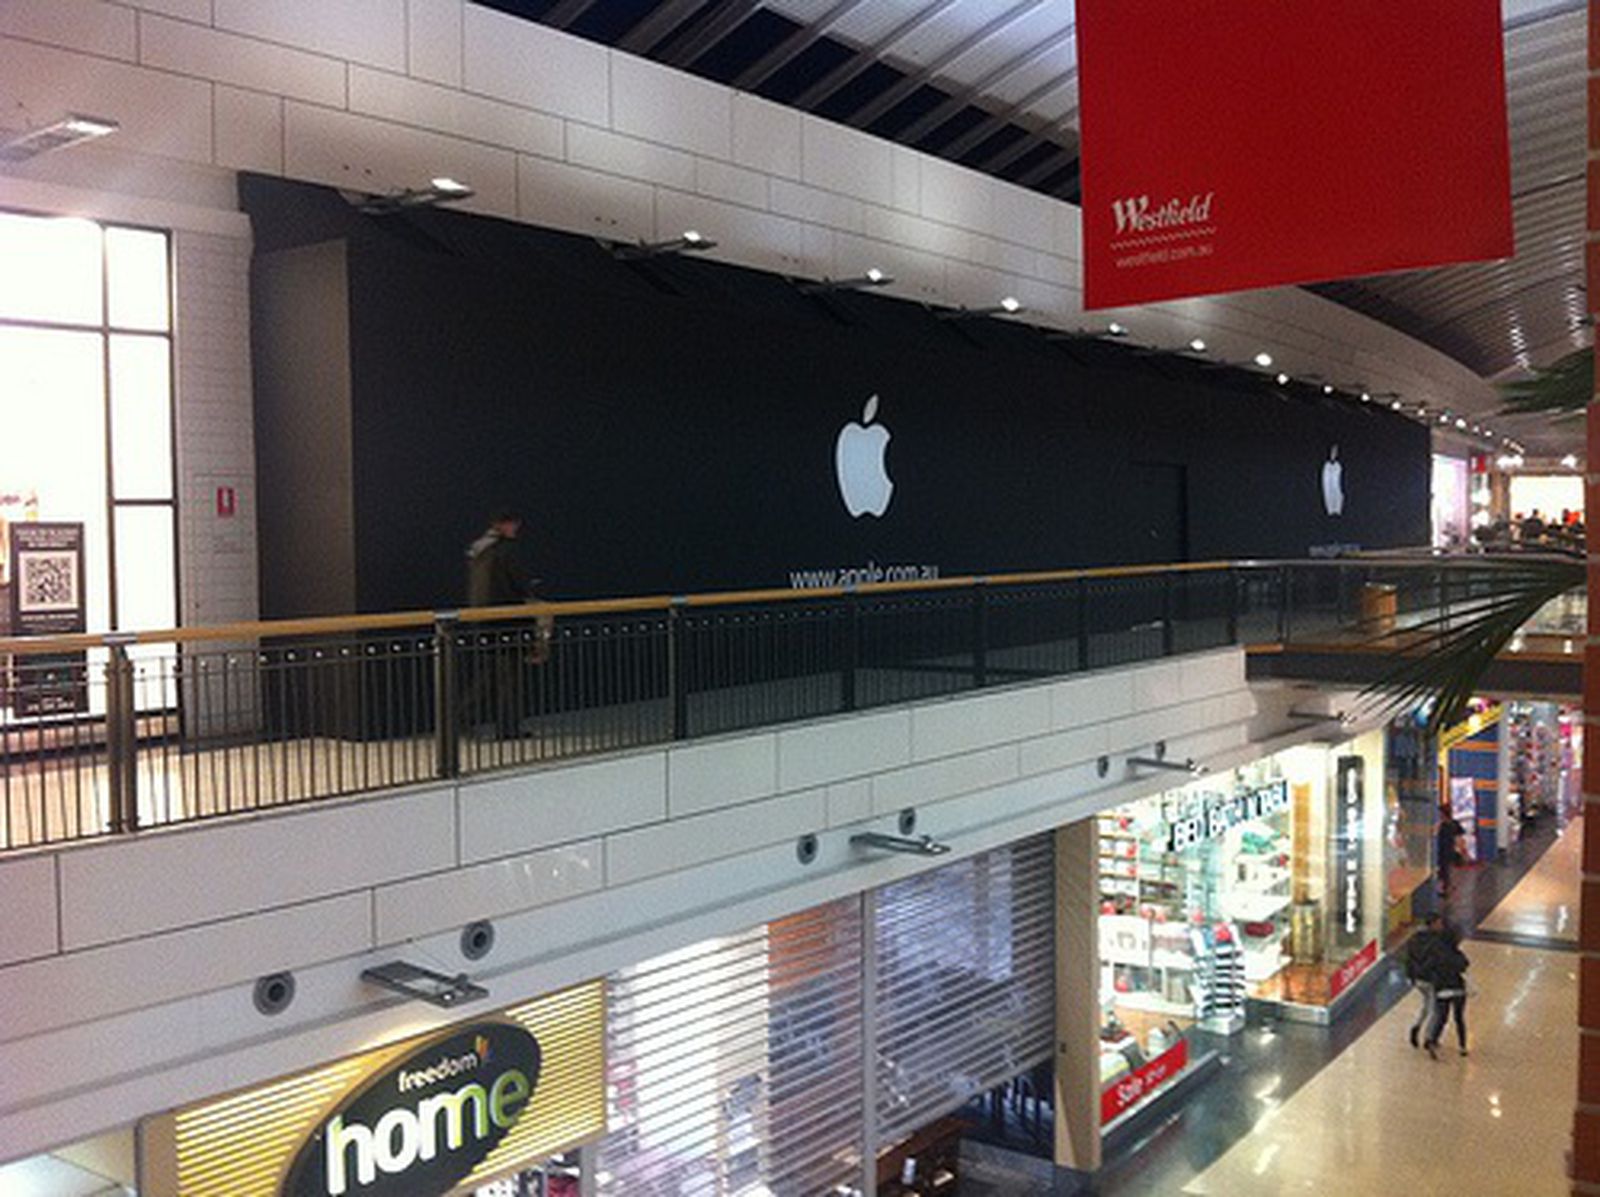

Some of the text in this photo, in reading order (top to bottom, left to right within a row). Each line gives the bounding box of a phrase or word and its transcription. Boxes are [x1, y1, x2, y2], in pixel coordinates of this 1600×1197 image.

[1111, 191, 1215, 234] Westfield
[398, 1051, 478, 1093] freedom
[326, 1069, 530, 1196] home
